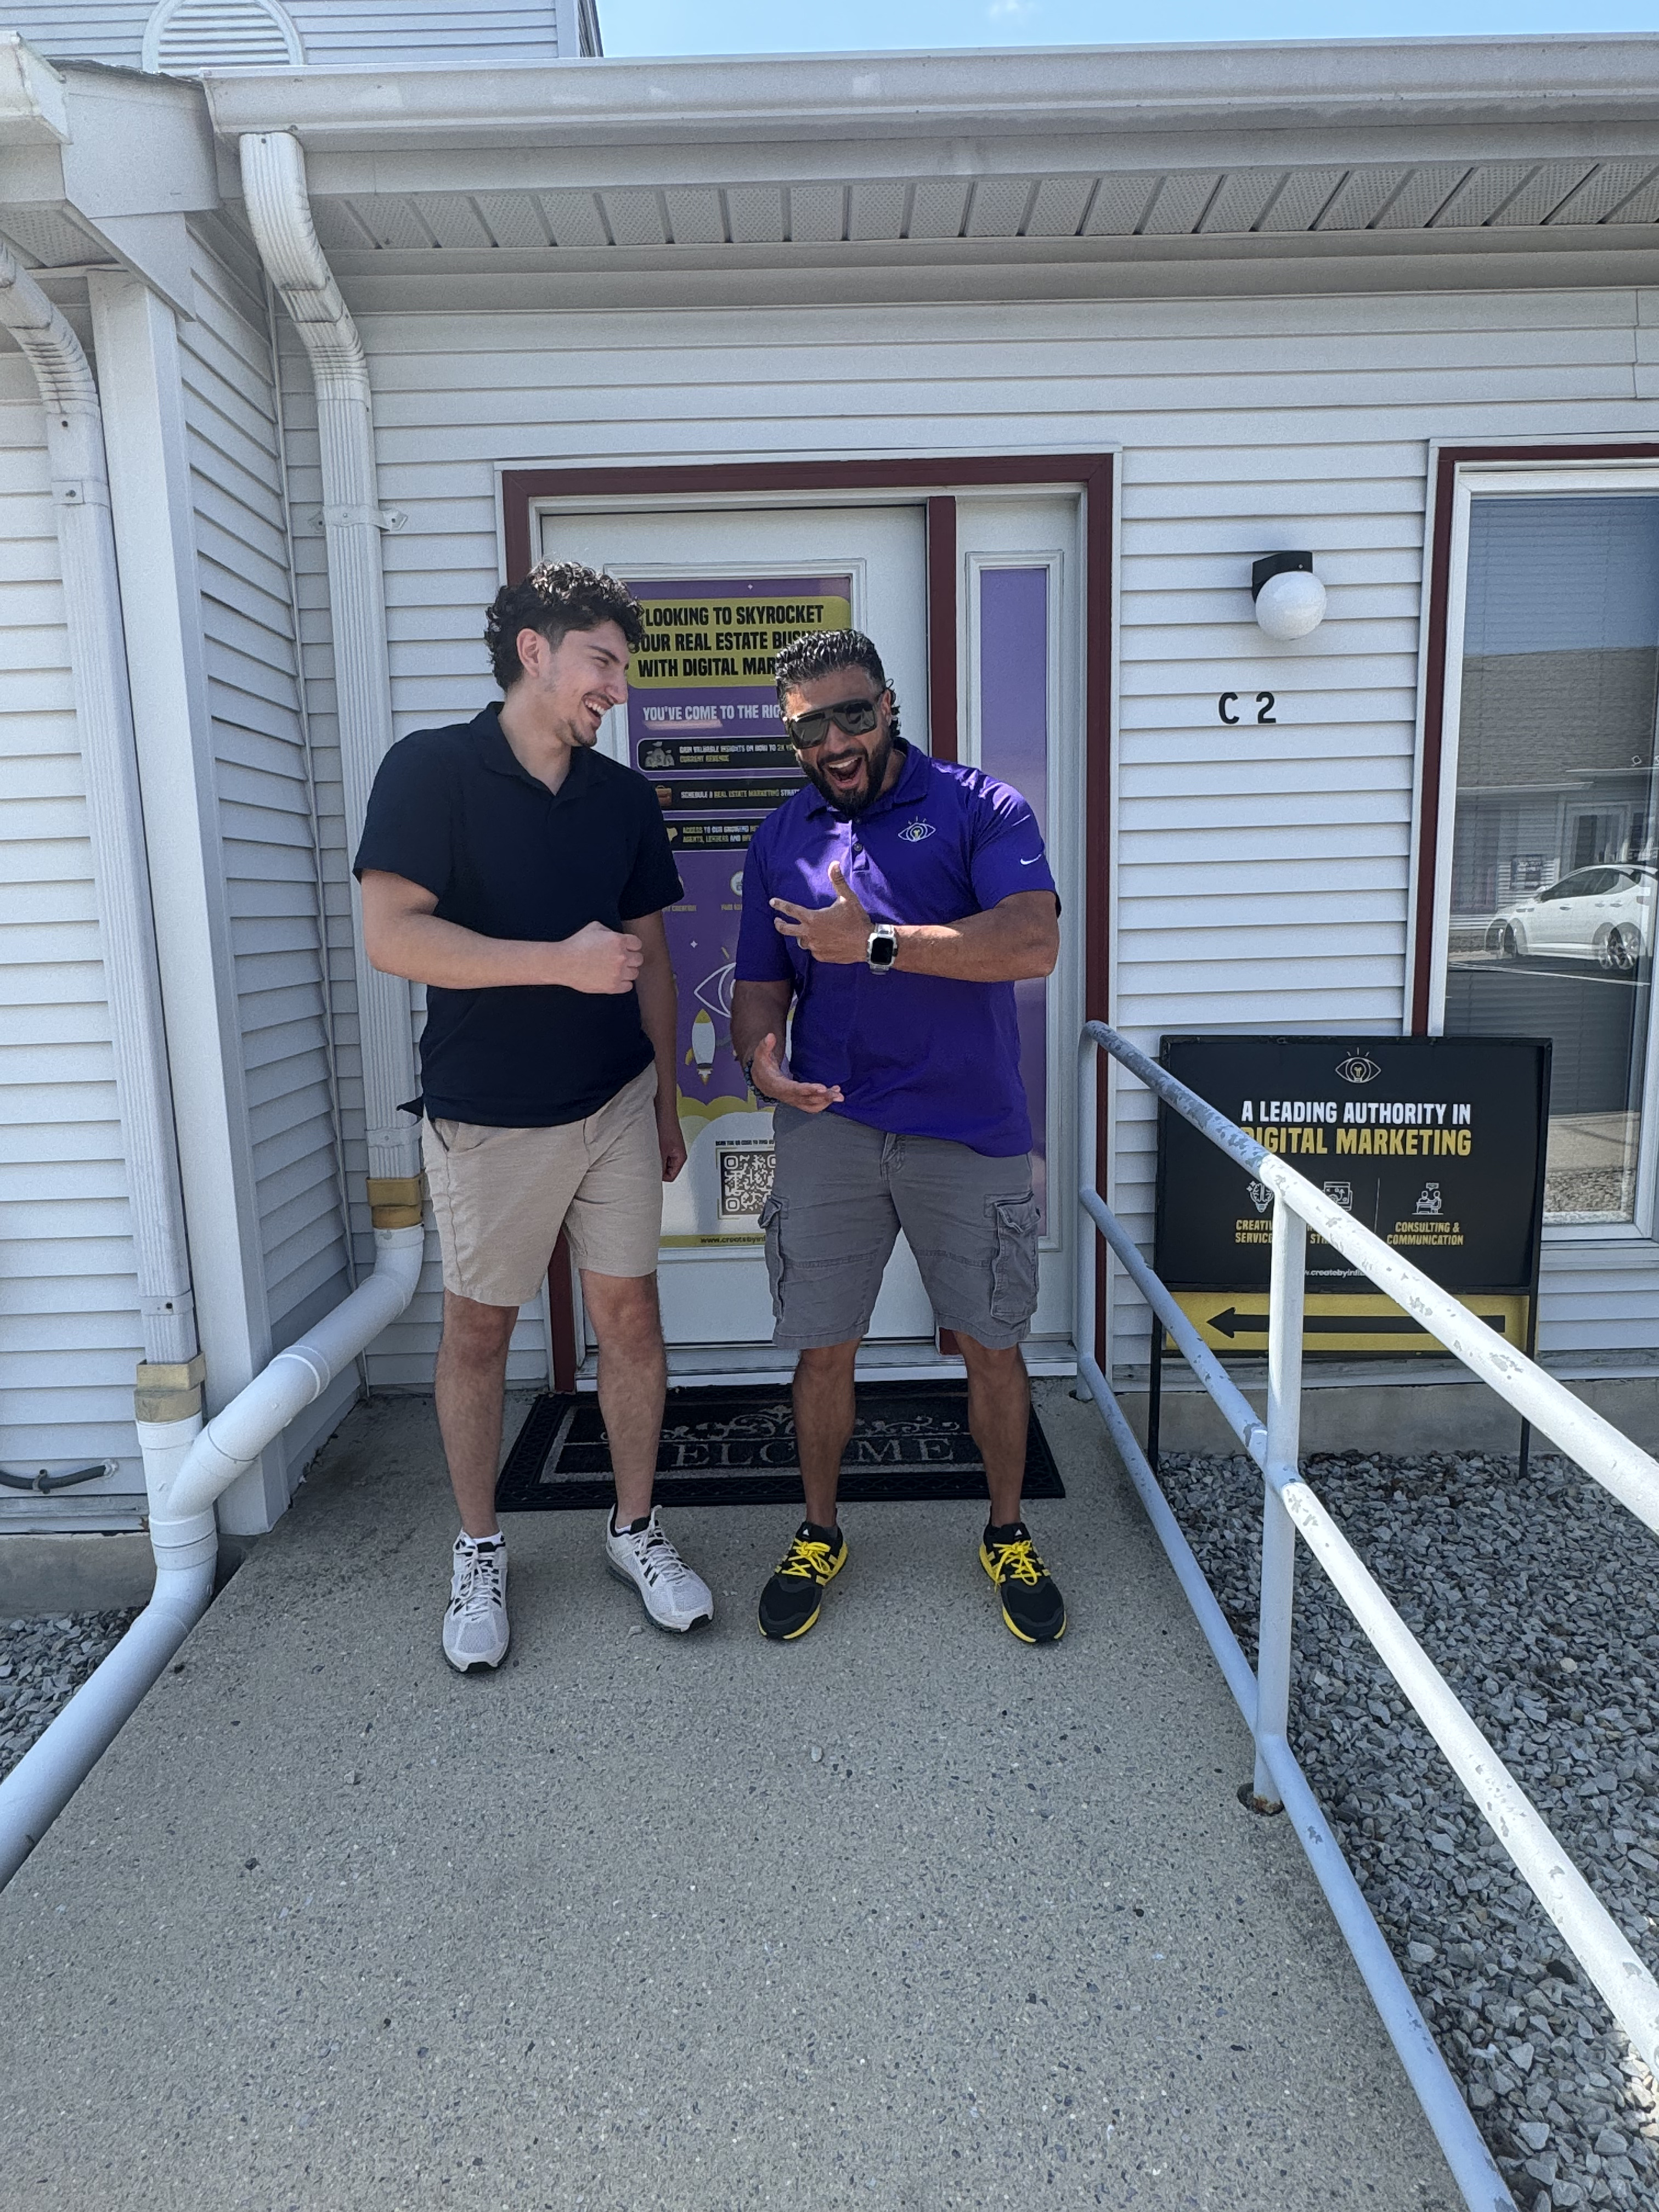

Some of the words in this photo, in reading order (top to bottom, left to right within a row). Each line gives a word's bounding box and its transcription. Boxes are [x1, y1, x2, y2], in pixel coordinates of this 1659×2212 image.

[645, 607, 709, 627] LOOKING
[713, 606, 732, 625] TO
[736, 605, 824, 624] SKYROCKET
[640, 633, 672, 652] OUR
[675, 633, 712, 652] REAL
[715, 631, 768, 651] ESTATE
[637, 658, 679, 678] WITH
[682, 657, 739, 676] DIGITAL
[743, 656, 776, 675] MAR
[643, 706, 682, 721] YOU'VE
[685, 706, 718, 720] COME
[720, 706, 735, 720] TO
[737, 705, 759, 719] THE
[762, 704, 781, 719] RIG
[1218, 692, 1240, 724] C
[1256, 691, 1276, 724] 2
[1241, 1101, 1253, 1122] A
[1260, 1101, 1338, 1123] LEADING
[1343, 1102, 1447, 1125] AUTHORITY
[1453, 1104, 1471, 1125] IN
[1240, 1127, 1328, 1154] IGITAL
[1336, 1128, 1471, 1156] MARKETING
[1235, 1219, 1273, 1231] CREATIV
[1395, 1221, 1451, 1233] CONSULTING
[1453, 1222, 1460, 1233] &
[1235, 1232, 1273, 1243] SERVICE
[1387, 1234, 1464, 1245] COMMUNICATION
[670, 1438, 954, 1467] ELCME
